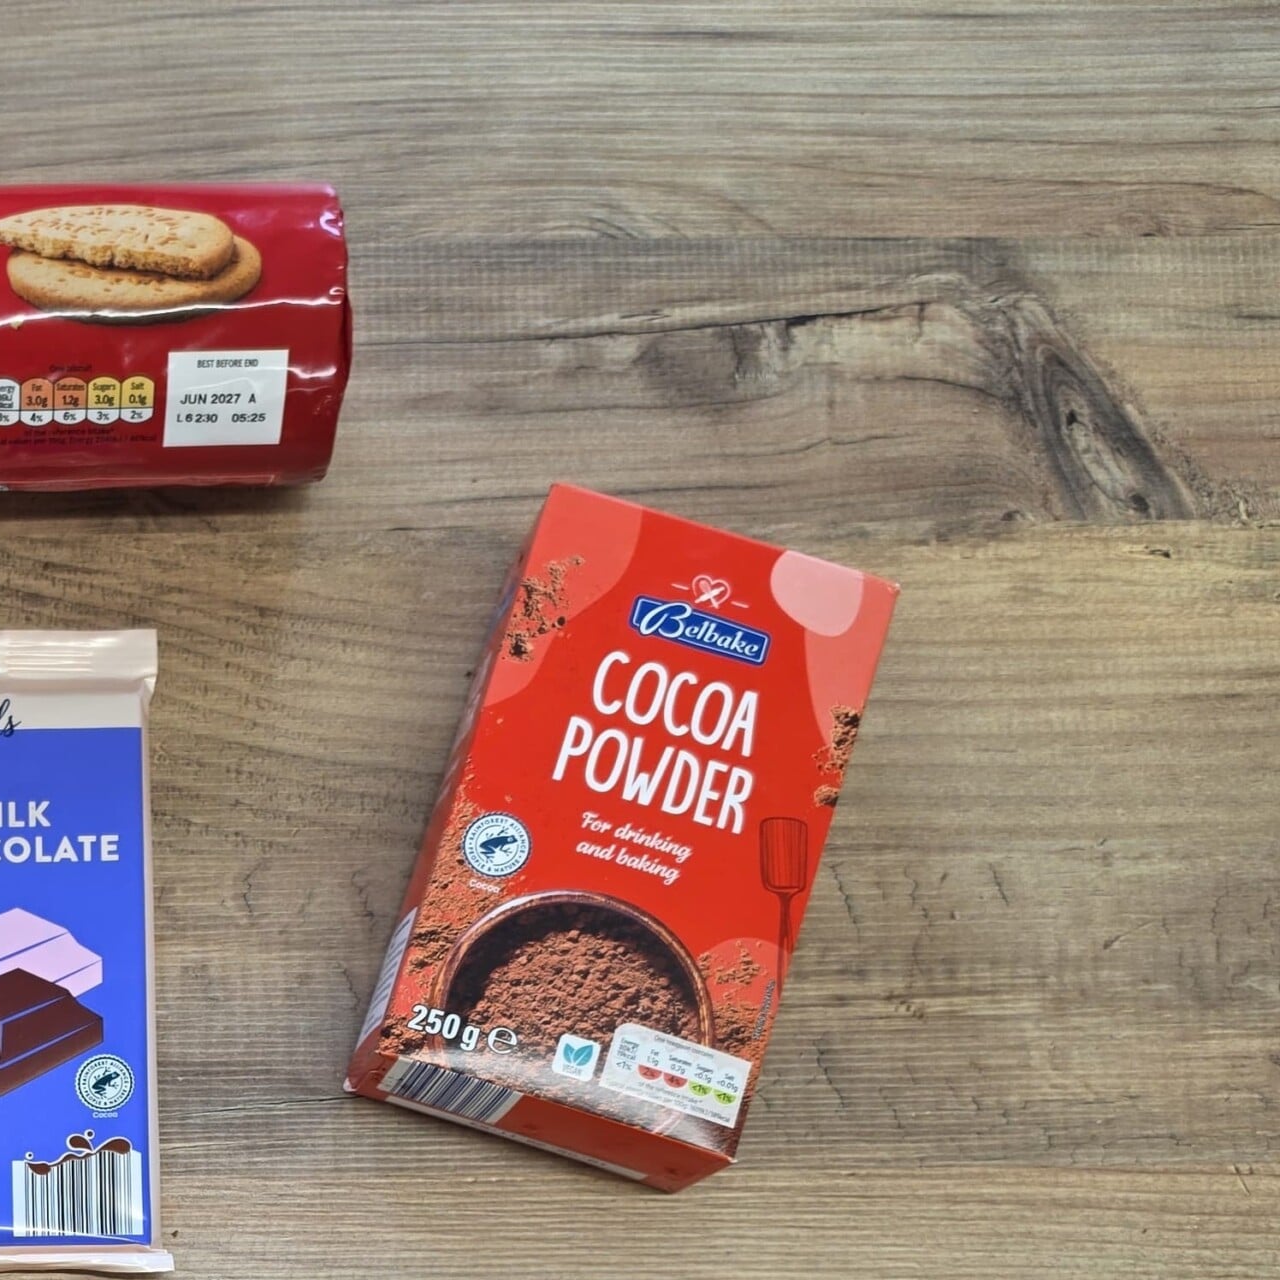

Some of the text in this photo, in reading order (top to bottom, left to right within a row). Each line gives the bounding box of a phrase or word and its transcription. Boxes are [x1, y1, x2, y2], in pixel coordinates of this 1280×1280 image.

[197, 358, 259, 369] BEST BEFORE END
[31, 383, 43, 391] Fat
[92, 383, 116, 392] Sugars
[131, 382, 144, 390] Salt
[26, 395, 48, 408] 3.0g
[95, 393, 115, 407] 3.0g
[128, 393, 147, 406] 0.1g
[180, 393, 257, 405] JUN 2027 A
[30, 413, 44, 422] 4%
[63, 412, 77, 421] 6%
[96, 411, 110, 421] 3%
[130, 410, 144, 419] 2%
[176, 413, 184, 423] L
[231, 413, 267, 423] 05:25
[639, 602, 759, 657] Belbake
[592, 651, 759, 758] COCOA
[551, 715, 755, 836] POWDER
[469, 818, 526, 853] RAINFOREST ALLIANCE
[581, 811, 693, 864] For drinking
[469, 846, 521, 872] PEOPLE NATURE
[576, 841, 682, 886] and baking
[470, 879, 501, 894] Cocoa
[407, 1004, 481, 1051] 250 g
[82, 1060, 108, 1086] RAINFOREST
[670, 1063, 686, 1075] 0.7g
